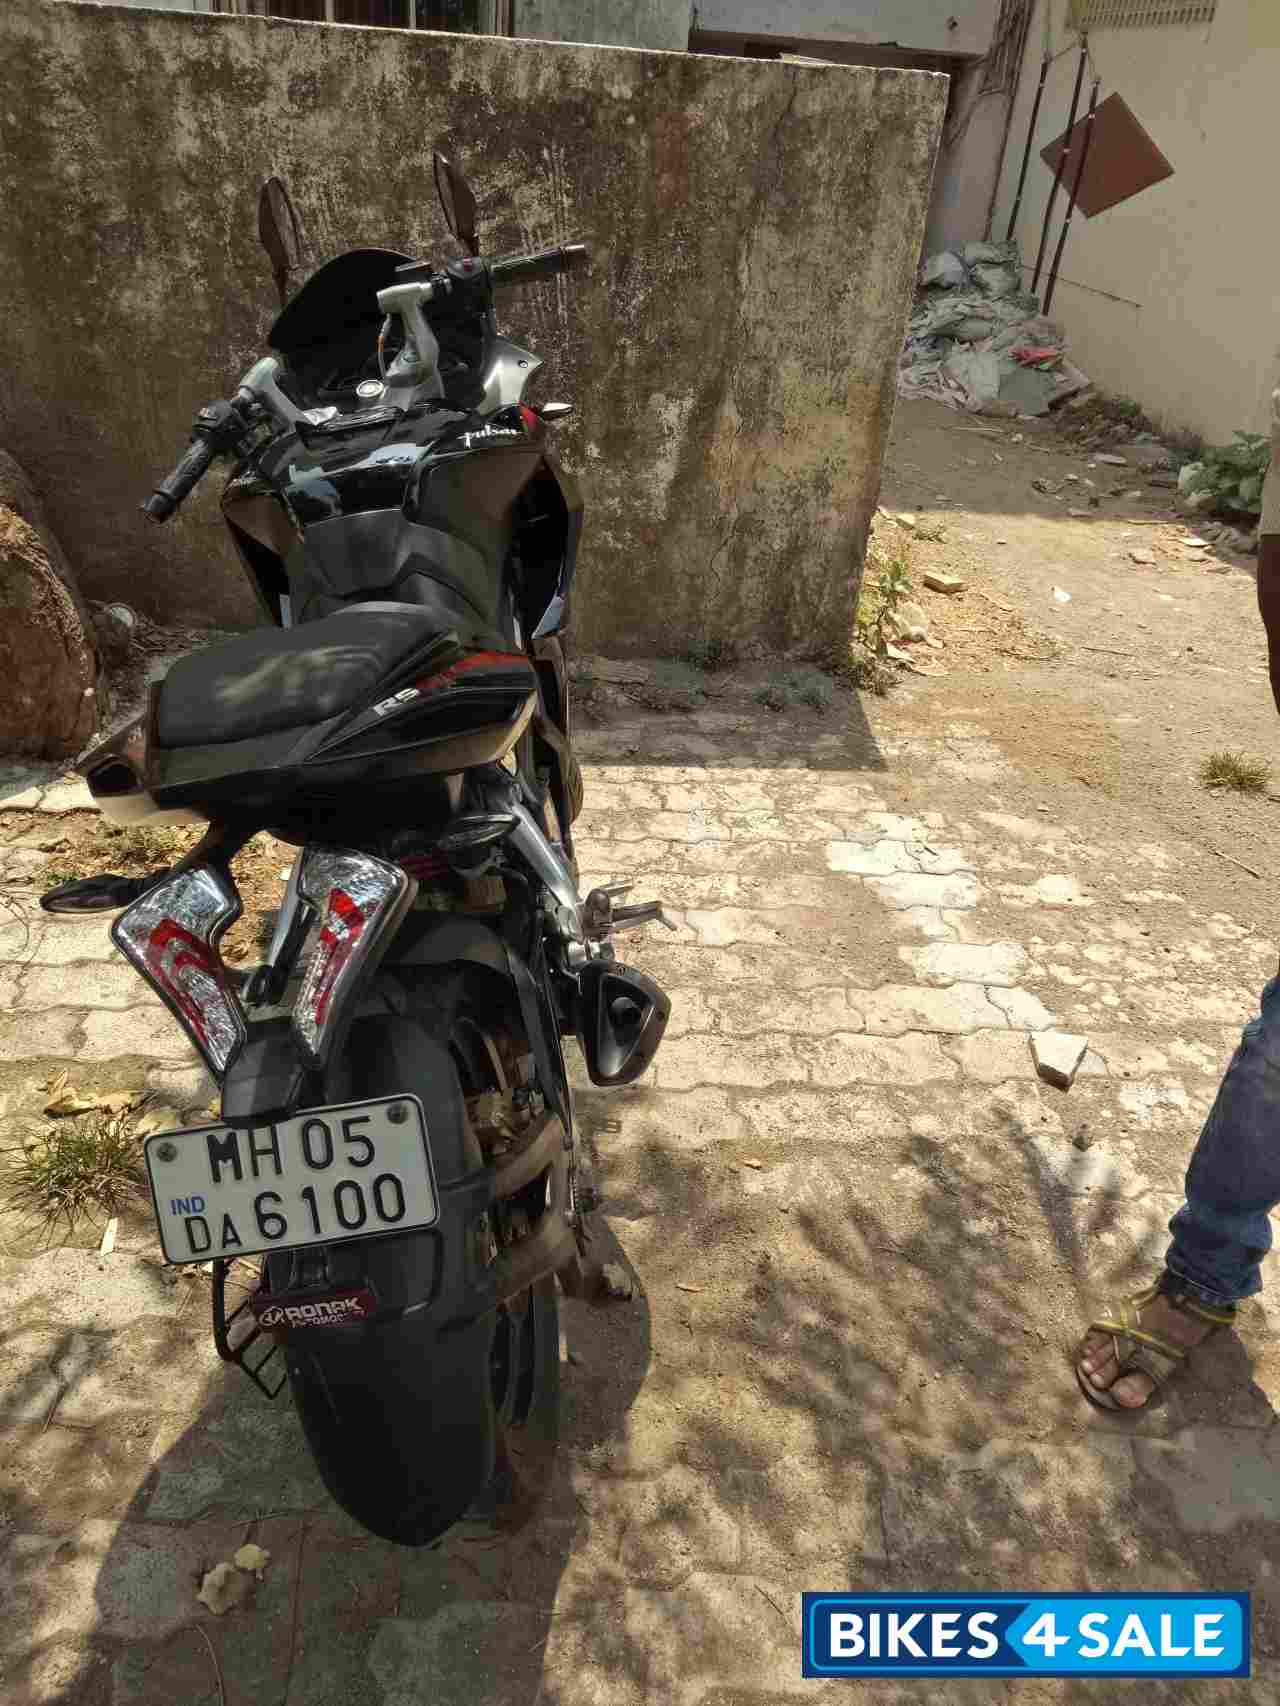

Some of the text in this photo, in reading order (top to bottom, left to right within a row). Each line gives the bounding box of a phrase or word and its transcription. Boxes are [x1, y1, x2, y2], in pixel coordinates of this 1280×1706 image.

[373, 687, 420, 716] RS
[206, 1115, 376, 1183] MH 05
[170, 1196, 206, 1216] IND
[253, 1173, 406, 1240] 6100
